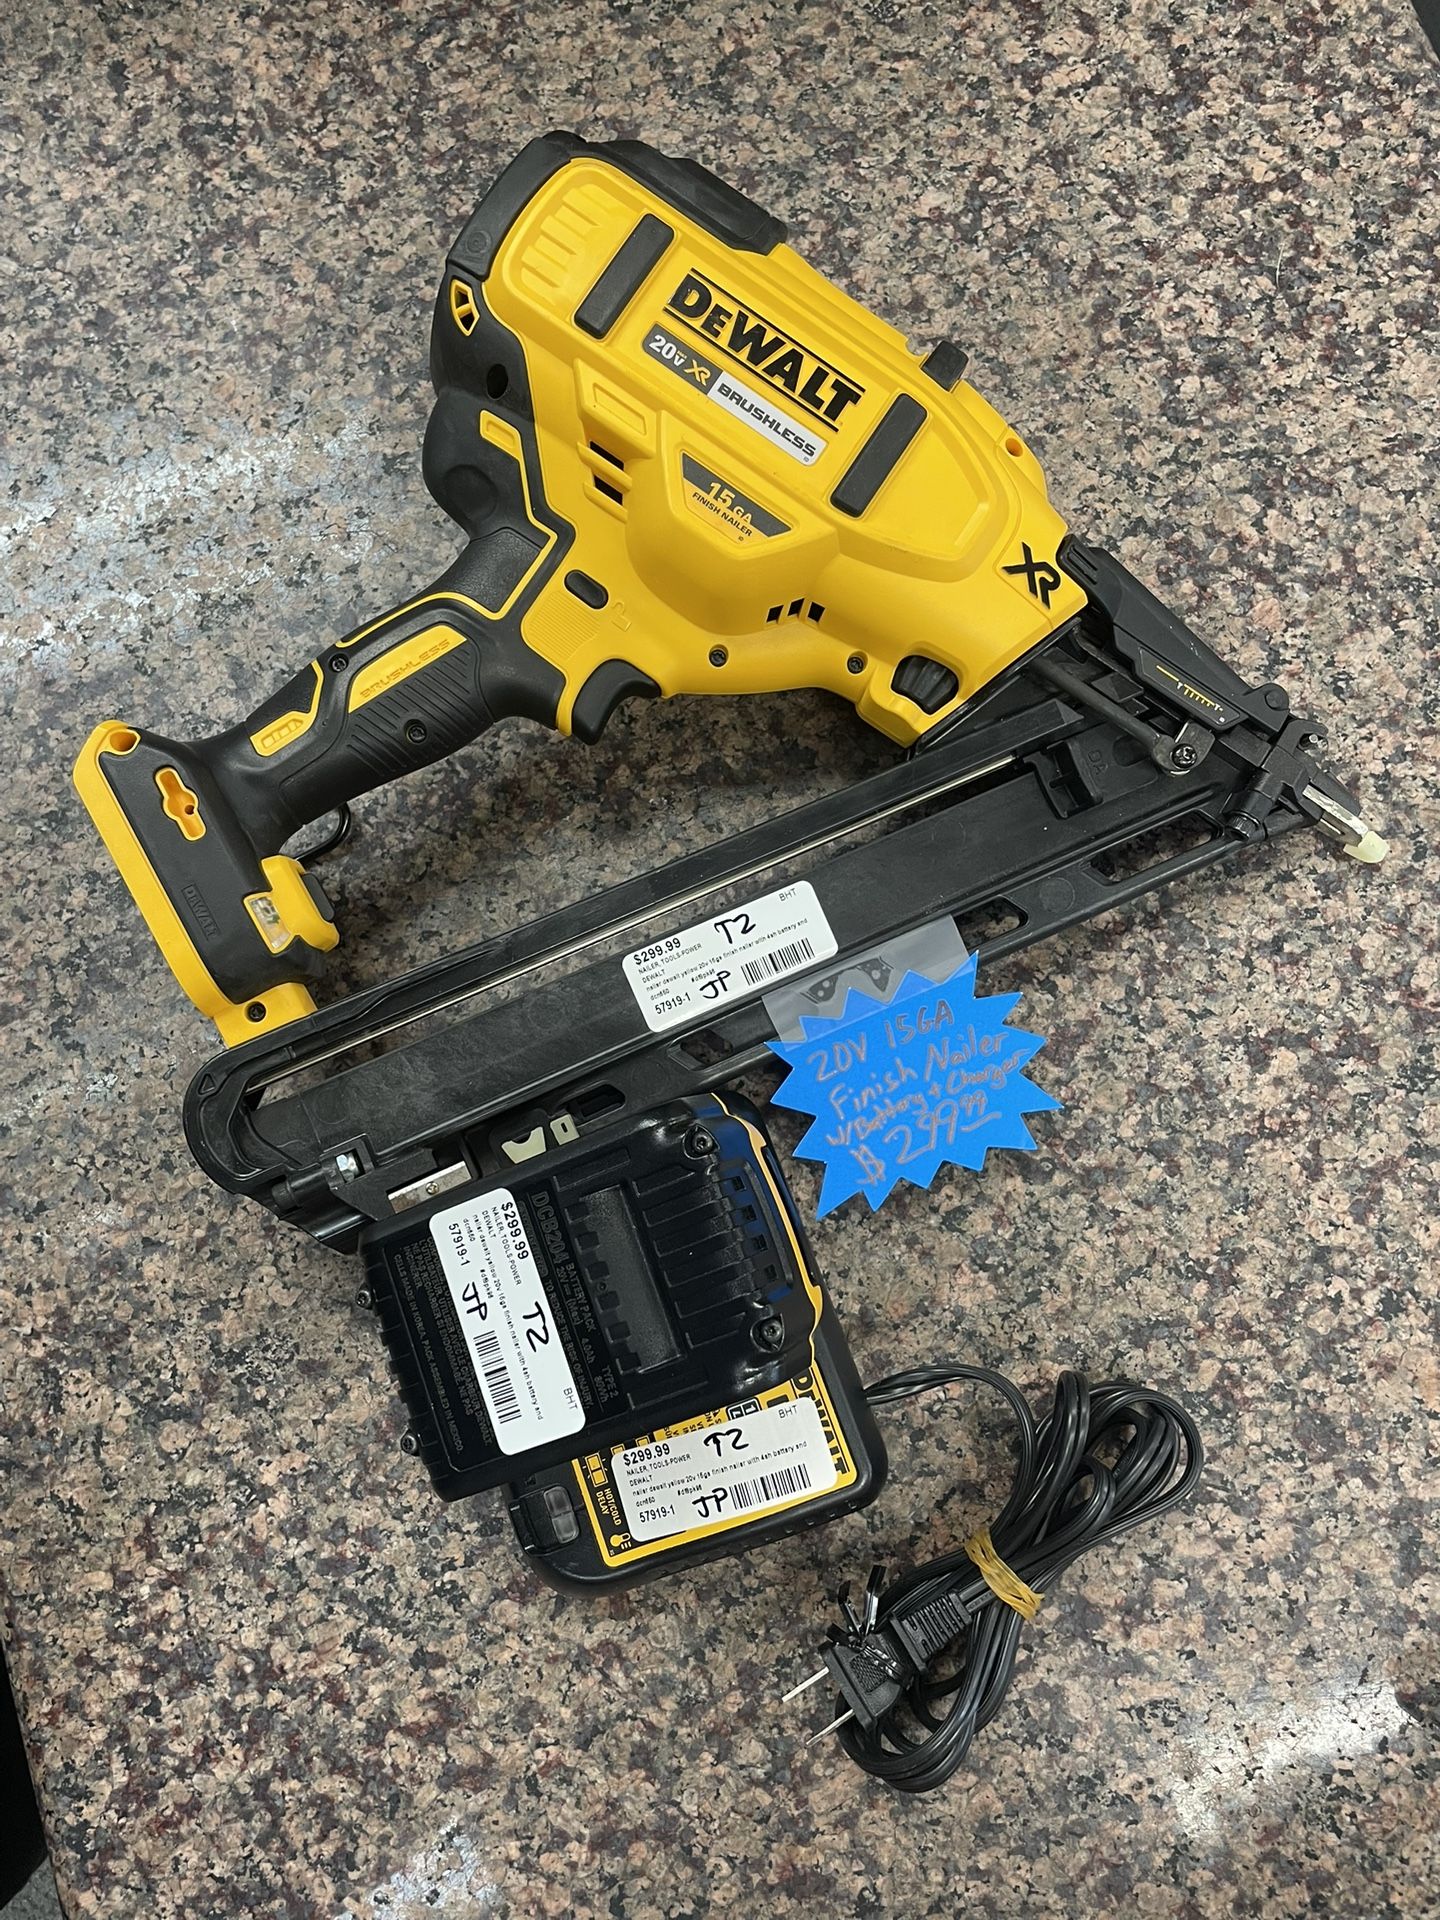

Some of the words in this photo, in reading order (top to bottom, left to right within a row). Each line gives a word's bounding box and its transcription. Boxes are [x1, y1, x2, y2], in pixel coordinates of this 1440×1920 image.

[668, 274, 861, 422] DEWALT
[684, 359, 711, 387] XR
[717, 382, 817, 457] BRUSHLESS
[692, 492, 721, 514] FINISH
[721, 511, 753, 537] NAILER
[1002, 541, 1062, 610] XR
[360, 639, 450, 698] BRUSHLESS
[778, 887, 797, 903] BHT
[713, 912, 757, 945] T2
[777, 922, 797, 935] battery
[796, 917, 807, 925] and
[633, 937, 681, 965] $299.99
[638, 960, 661, 974] NAILER,
[642, 969, 665, 983] DEWALT
[699, 970, 731, 1000] JP
[654, 991, 690, 1014] 57919-1
[805, 1031, 867, 1082] 20V
[828, 1058, 917, 1120] Finish
[925, 1025, 1009, 1082] Nailer
[946, 1048, 1031, 1096] Charger
[482, 1210, 495, 1238] DEWALT
[500, 1201, 529, 1259] $299.99
[530, 1190, 570, 1264] DCB204
[448, 1222, 470, 1265] 57919-1
[491, 1206, 504, 1232] NAILER,
[500, 1234, 521, 1285] TOOLS-POWER
[544, 1279, 554, 1292] TO
[461, 1281, 489, 1321] JP
[548, 1291, 566, 1325] REDUCE
[472, 1214, 482, 1232] nailer
[479, 1234, 490, 1255] dewalt
[485, 1256, 498, 1278] yellow
[504, 1309, 514, 1328] finish
[510, 1330, 521, 1349] nailer
[517, 1350, 526, 1365] with
[525, 1381, 538, 1404] battery
[534, 1406, 543, 1419] and
[522, 1301, 550, 1352] T2
[565, 1262, 587, 1304] BATTERY
[580, 1305, 596, 1332] PACK
[600, 1365, 616, 1390] TYPE
[393, 1253, 406, 1277] CELLS
[401, 1277, 414, 1301] MADE
[409, 1301, 418, 1311] IN
[421, 1339, 434, 1361] PACK
[428, 1361, 449, 1408] ASSEMBLED
[444, 1409, 453, 1419] IN
[559, 1324, 571, 1341] THE
[565, 1341, 579, 1363] RISK
[572, 1362, 583, 1374] OF
[563, 1387, 578, 1411] BHT
[778, 1405, 798, 1420] BHT
[622, 1441, 670, 1466] $299.99
[703, 1428, 749, 1457] T2
[747, 1456, 759, 1464] with
[773, 1445, 794, 1456] battery
[795, 1441, 807, 1449] and
[626, 1465, 647, 1477] NAILER,
[649, 1452, 691, 1470] TOOLS-POWER
[629, 1475, 652, 1486] DEWALT
[596, 1491, 610, 1515] DELAY
[604, 1487, 622, 1526] HOT/COLD
[639, 1503, 674, 1523] 57919-1
[692, 1487, 728, 1518] JP
